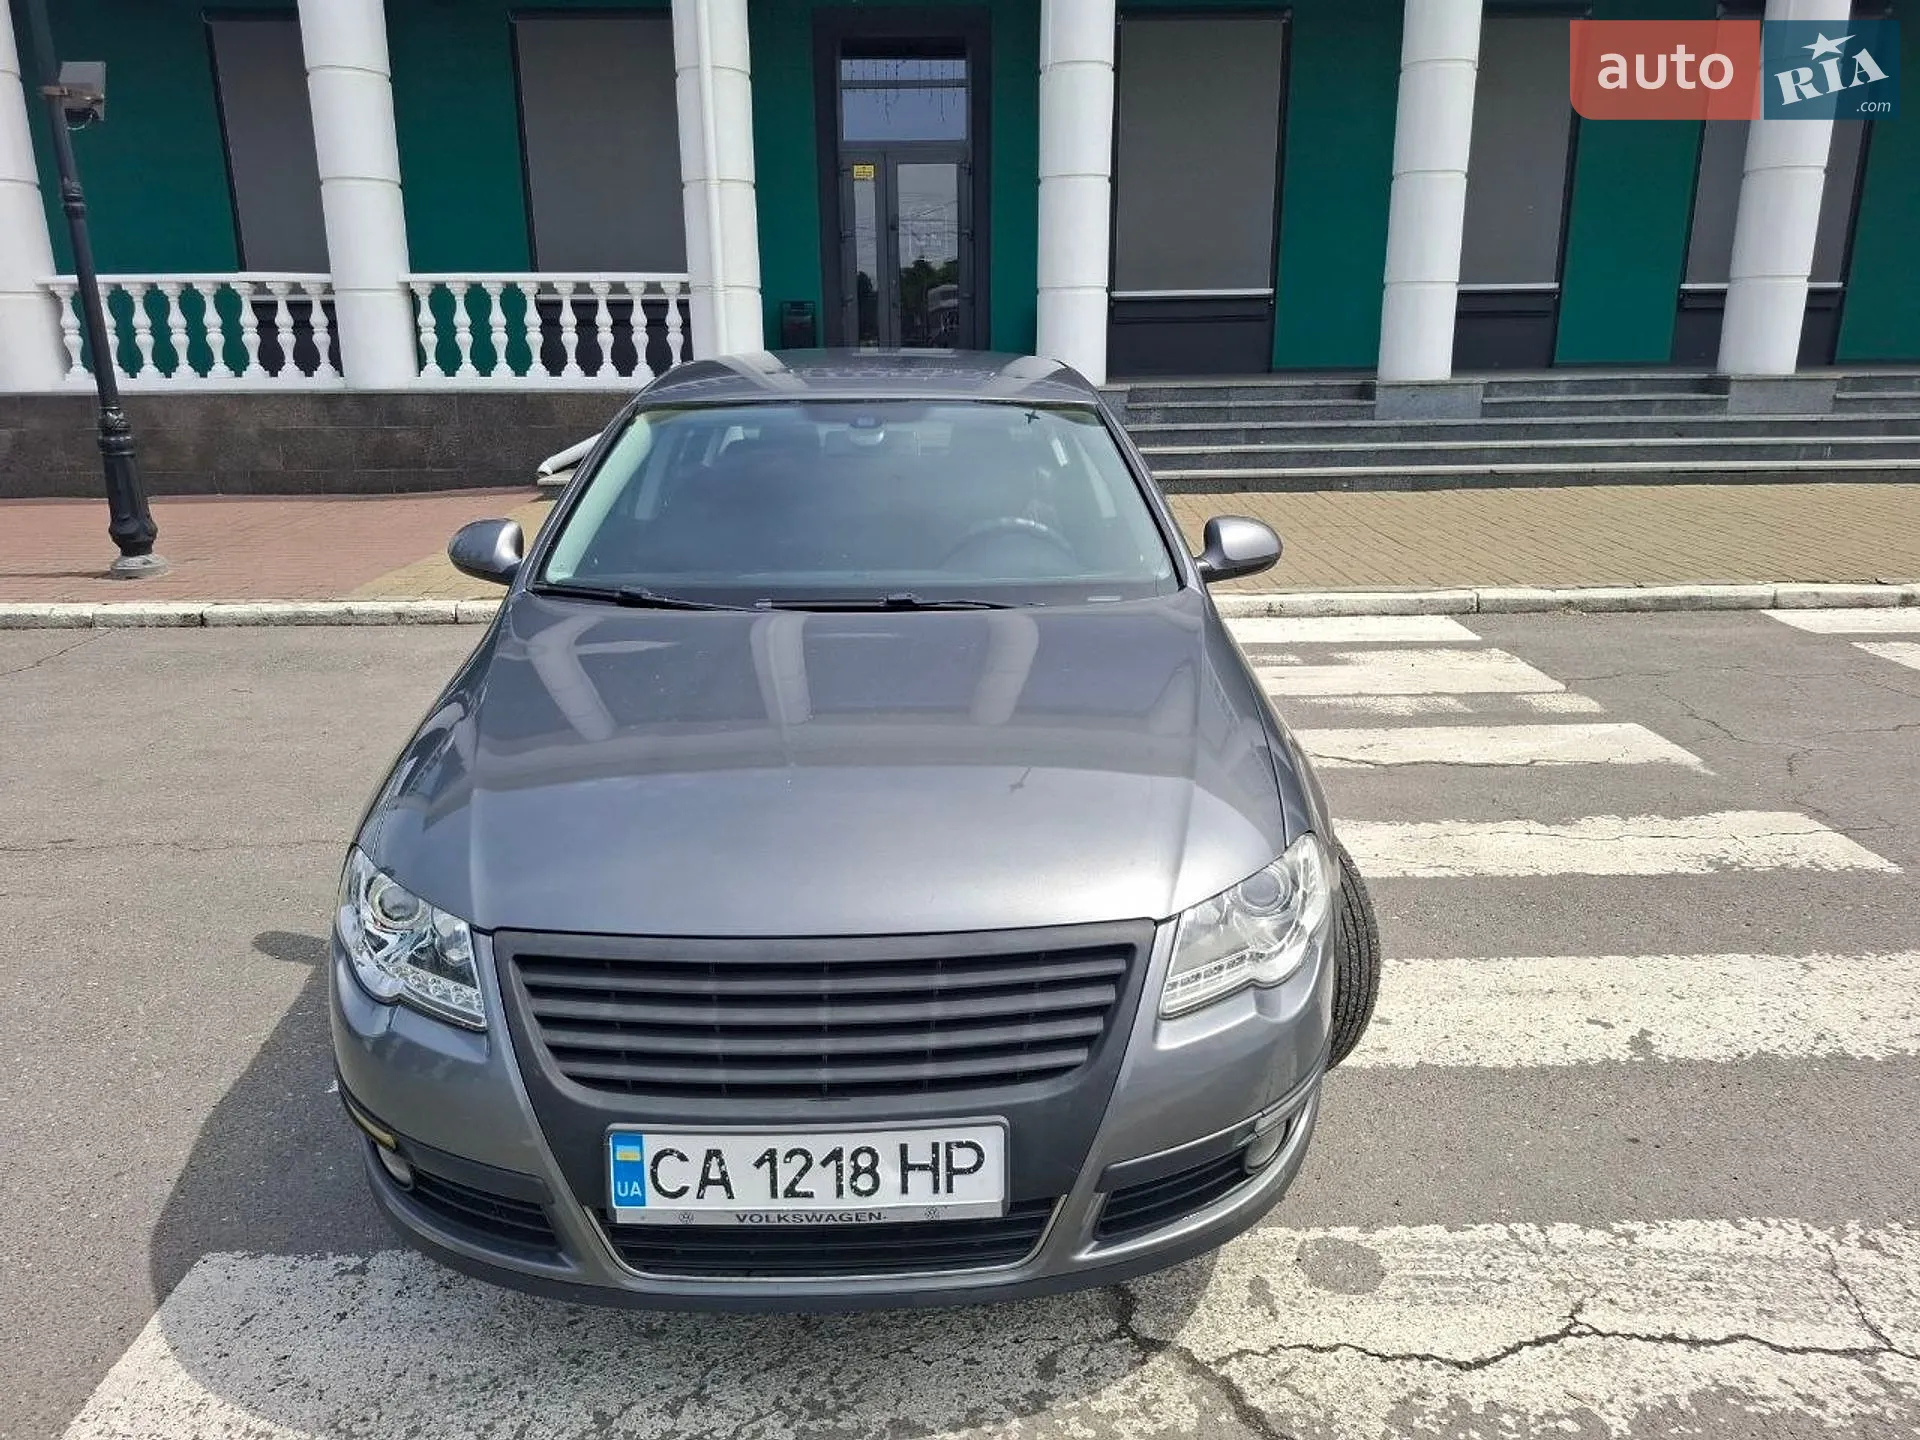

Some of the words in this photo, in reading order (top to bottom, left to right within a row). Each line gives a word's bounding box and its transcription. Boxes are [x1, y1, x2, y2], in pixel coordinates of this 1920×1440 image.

[616, 1181, 642, 1197] UA
[650, 1148, 735, 1200] CA
[752, 1146, 881, 1200] 1218
[899, 1140, 986, 1195] HP
